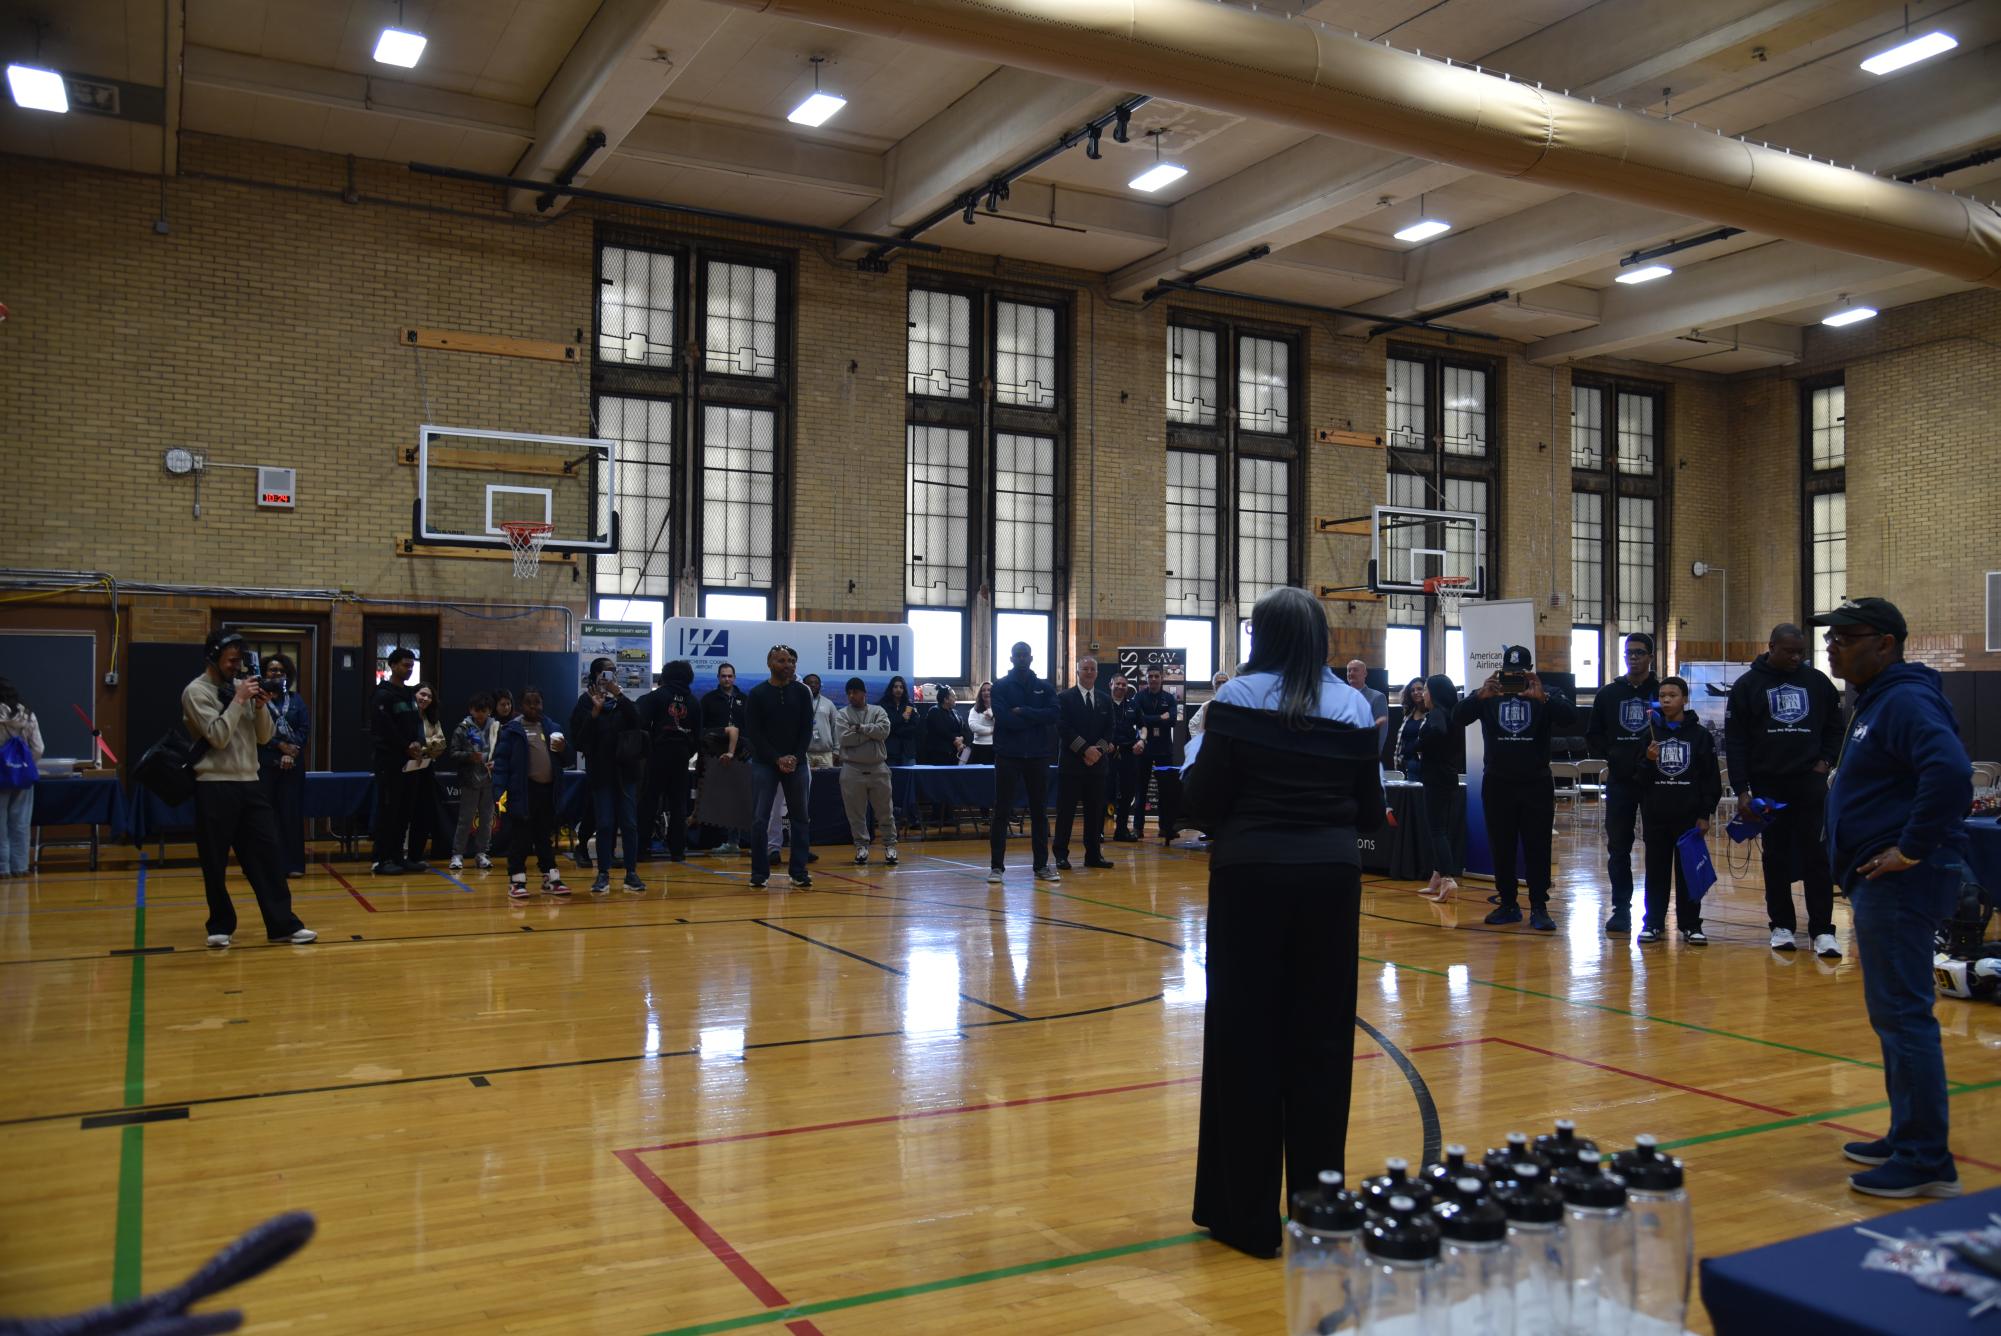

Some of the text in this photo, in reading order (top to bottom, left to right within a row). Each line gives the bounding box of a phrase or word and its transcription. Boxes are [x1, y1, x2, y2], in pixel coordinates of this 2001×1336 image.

[834, 633, 899, 672] HPN
[1470, 651, 1503, 660] American
[1476, 660, 1503, 669] Airlines
